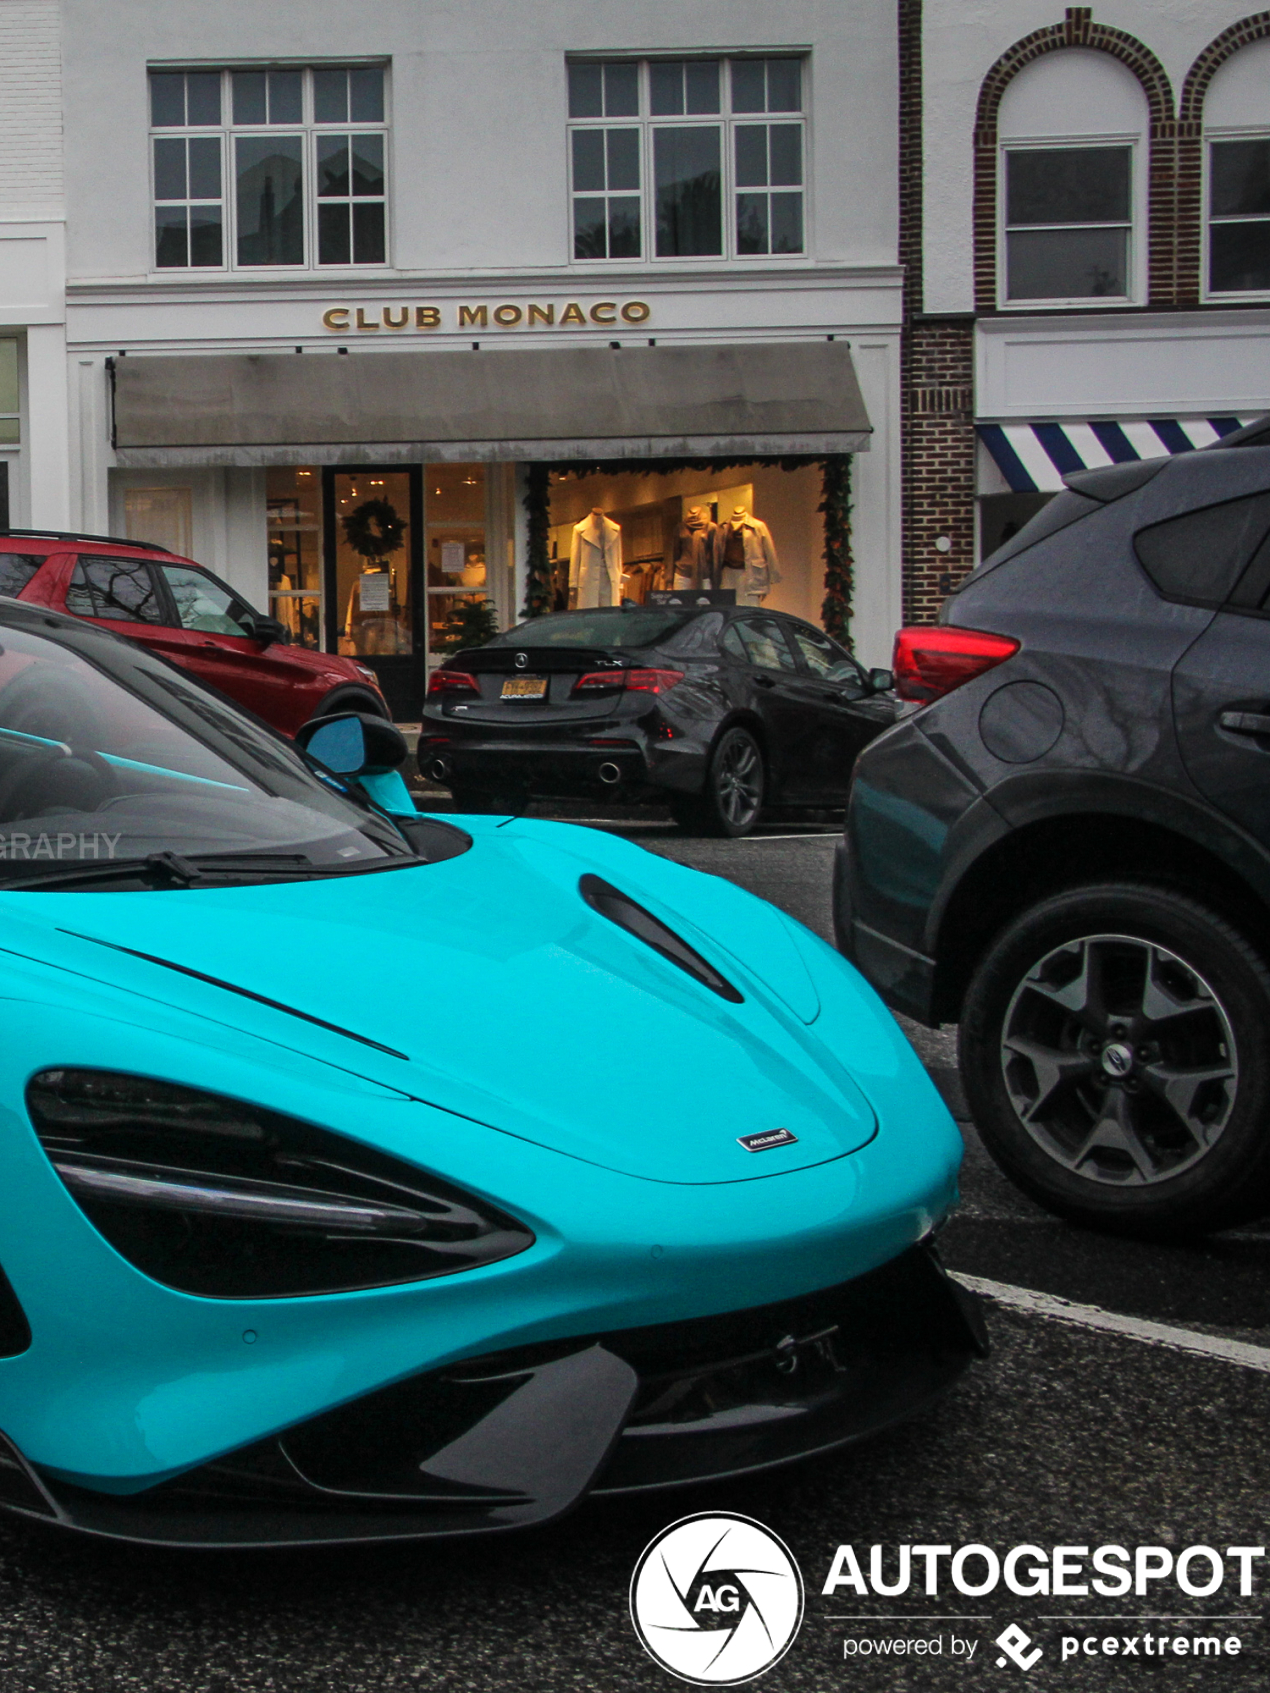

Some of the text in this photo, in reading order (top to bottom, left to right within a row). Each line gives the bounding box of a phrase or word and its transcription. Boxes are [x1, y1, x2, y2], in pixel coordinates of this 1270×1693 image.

[322, 301, 651, 330] CLUB MONACO
[750, 1132, 788, 1147] McLaren
